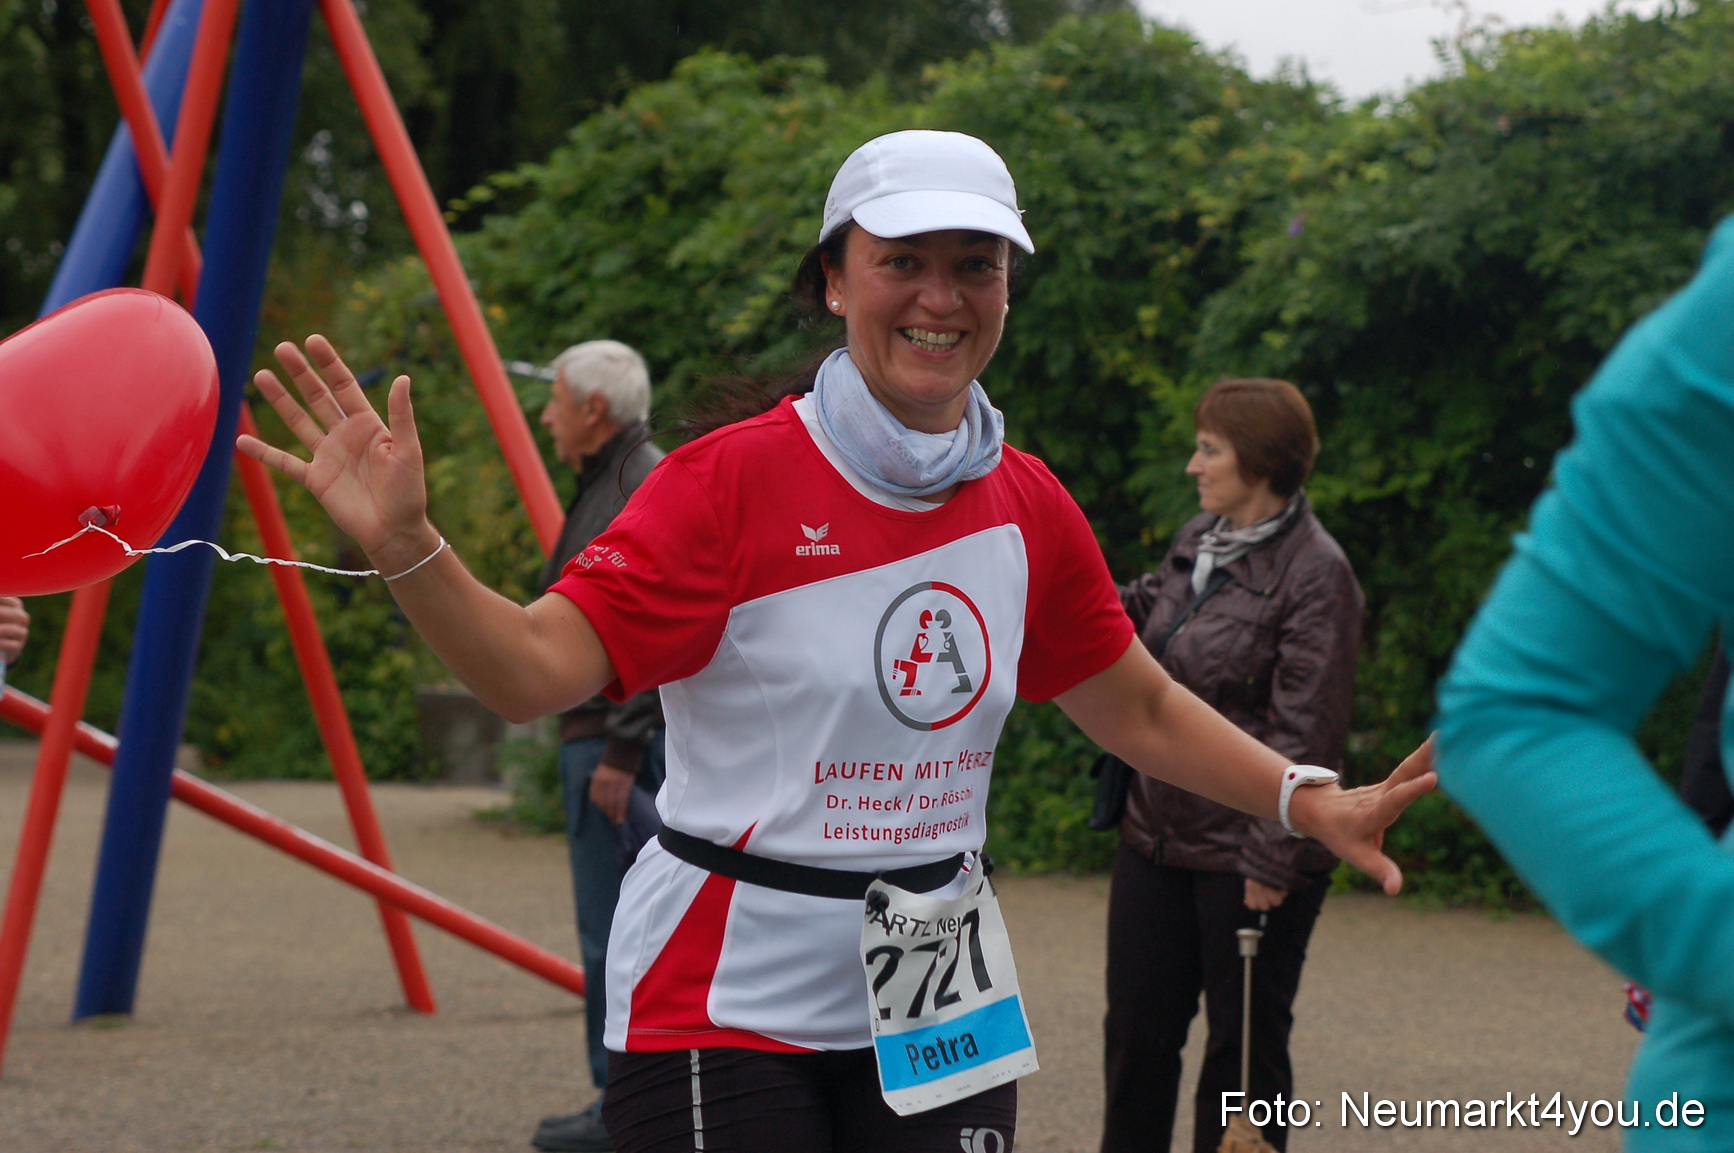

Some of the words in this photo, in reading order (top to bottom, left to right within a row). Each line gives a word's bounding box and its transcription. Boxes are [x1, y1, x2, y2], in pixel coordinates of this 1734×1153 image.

[795, 541, 841, 556] erima
[814, 761, 903, 784] LAUFEN
[914, 760, 953, 780] MIT
[826, 794, 852, 810] Dr.
[858, 795, 902, 811] Heck
[919, 794, 939, 810] Dr.
[824, 811, 970, 844] Leistungsdiagnostik
[865, 907, 993, 1020] 2721
[905, 1032, 980, 1076] Petra
